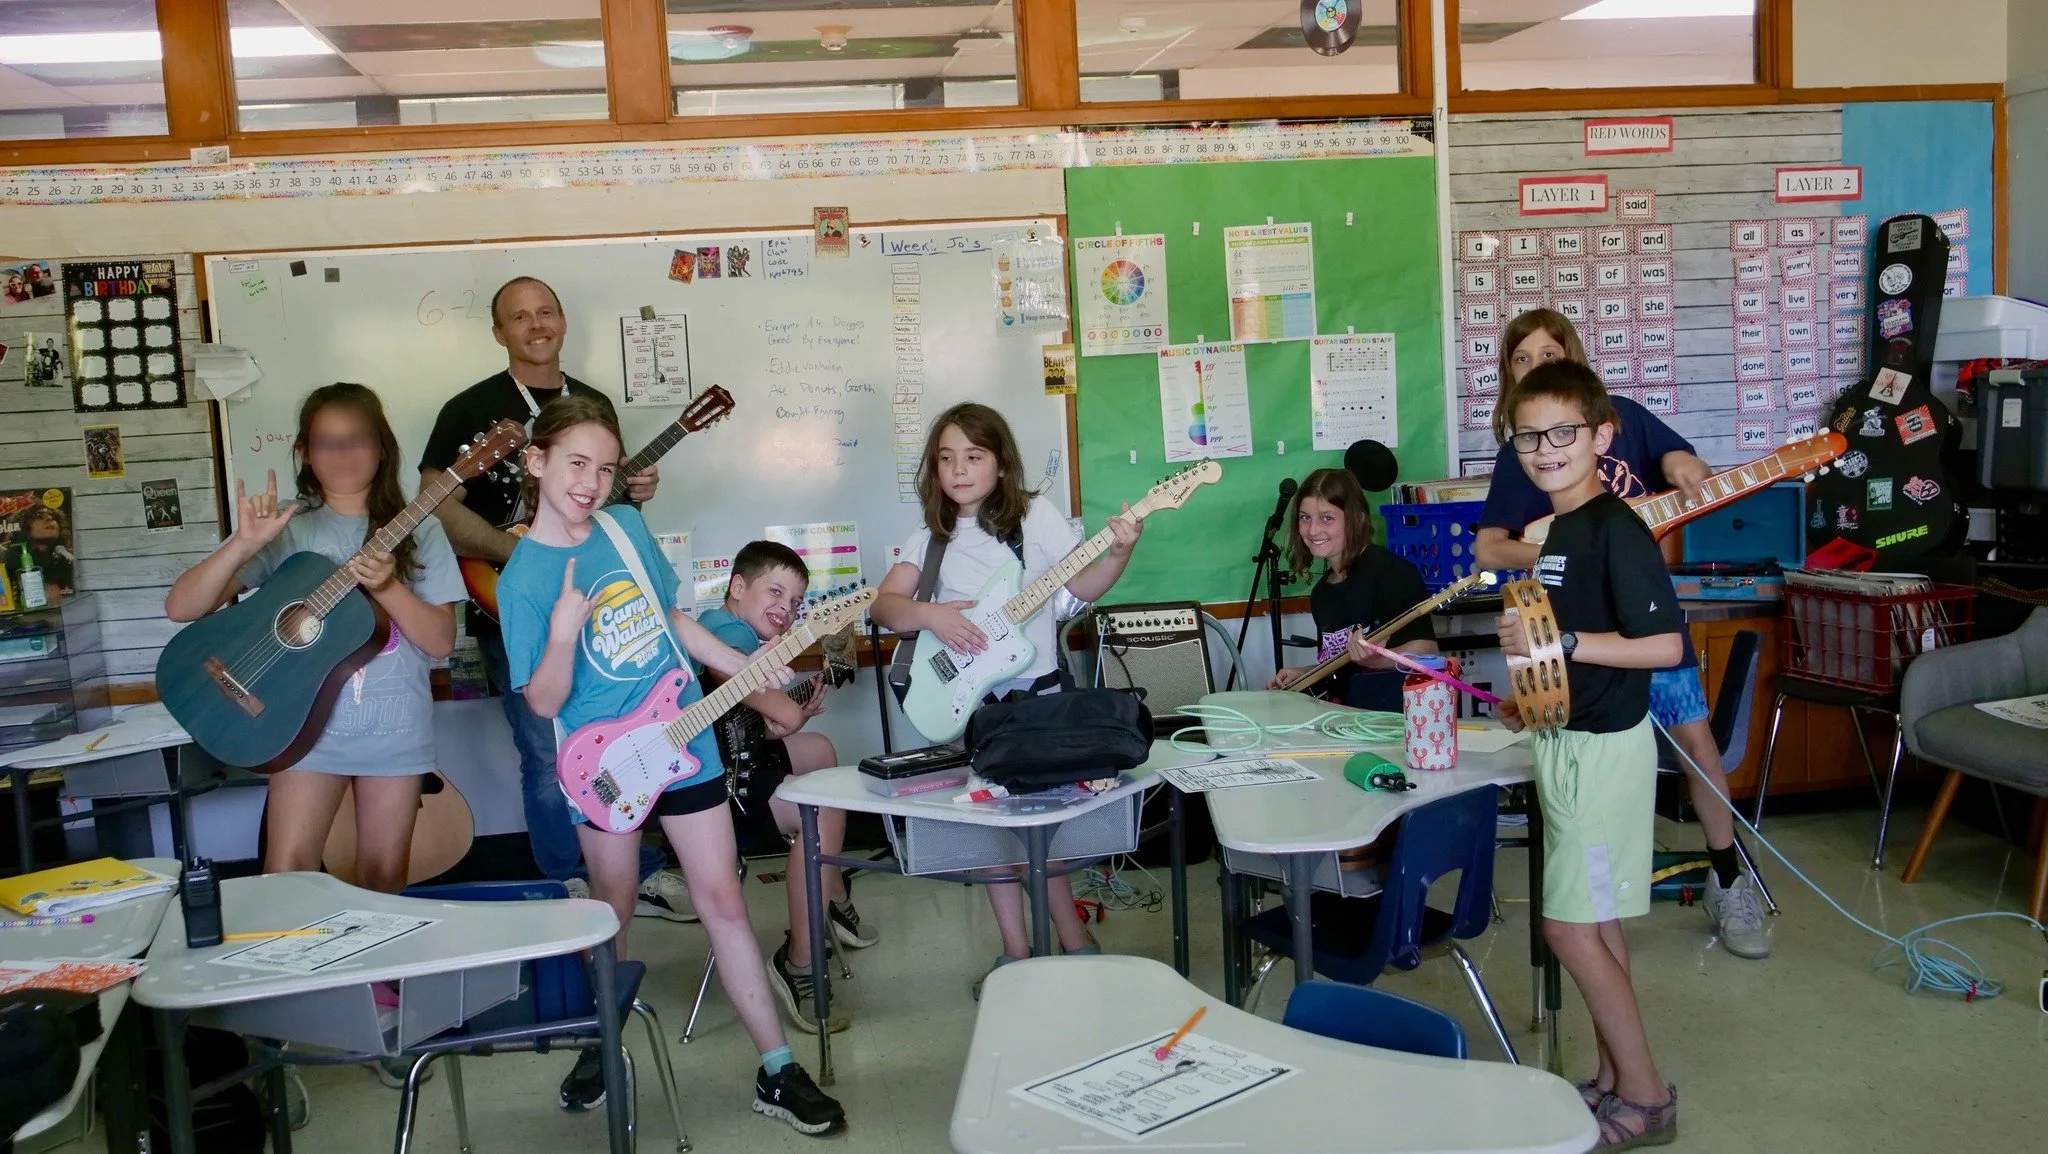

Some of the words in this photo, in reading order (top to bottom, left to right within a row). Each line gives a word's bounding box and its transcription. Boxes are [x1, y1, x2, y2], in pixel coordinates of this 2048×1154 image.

[1589, 126, 1617, 140] RED
[1619, 127, 1667, 139] WORDS
[6, 186, 19, 196] 24
[27, 186, 40, 196] 25
[69, 185, 82, 195] 27
[90, 185, 104, 195] 28
[130, 184, 144, 194] 30
[151, 184, 162, 194] 31
[192, 181, 205, 192] 33
[213, 181, 225, 191] 34
[249, 178, 262, 189] 36
[289, 177, 302, 188] 38
[328, 176, 342, 186] 40
[365, 175, 378, 185] 42
[385, 174, 398, 184] 43
[444, 171, 458, 181] 46
[480, 170, 493, 180] 48
[559, 167, 571, 177] 52
[592, 166, 604, 176] 54
[611, 165, 624, 177] 55
[650, 164, 662, 174] 57
[669, 163, 681, 174] 58
[704, 162, 716, 173] 60
[779, 160, 791, 170] 64
[797, 159, 809, 169] 65
[830, 156, 842, 168] 67
[867, 154, 879, 166] 69
[903, 155, 914, 164] 71
[919, 155, 931, 165] 72
[938, 154, 949, 165] 73
[1009, 151, 1021, 160] 77
[1024, 150, 1036, 160] 78
[1095, 147, 1106, 157] 82
[1126, 146, 1138, 155] 84
[1179, 144, 1190, 154] 87
[1196, 143, 1208, 153] 88
[1227, 143, 1239, 152] 90
[1279, 140, 1291, 150] 93
[1296, 139, 1307, 149] 94
[1328, 138, 1340, 147] 96
[1362, 136, 1374, 146] 98
[1395, 135, 1410, 145] 100
[1786, 177, 1833, 192] LAYER
[1843, 177, 1851, 190] 2
[1531, 188, 1579, 202] LAYER
[1590, 189, 1595, 201] 1
[1625, 198, 1647, 211] said
[1228, 230, 1250, 238] NOTE
[1257, 228, 1277, 237] REST
[1278, 226, 1309, 235] VALUES
[1743, 230, 1755, 241] all
[1791, 229, 1804, 237] as
[1838, 227, 1859, 238] even
[1077, 239, 1113, 250] CIRCLE
[1114, 239, 1128, 248] OF
[1129, 237, 1163, 247] FIFTHS
[1520, 238, 1527, 250] I
[1557, 237, 1577, 249] the
[1601, 235, 1621, 247] for
[1642, 233, 1664, 245] and
[1475, 243, 1483, 252] a
[1787, 261, 1811, 273] every
[1834, 256, 1859, 268] watch
[97, 265, 140, 280] HAPPY
[1604, 267, 1619, 279] of
[1642, 267, 1665, 279] was
[1740, 263, 1763, 275] many
[1475, 275, 1484, 286] is
[1514, 275, 1536, 285] see
[1558, 271, 1579, 283] has
[84, 279, 153, 297] BIRTHDAY
[1788, 294, 1805, 304] live
[1833, 290, 1858, 302] very
[1562, 302, 1578, 315] his
[1605, 303, 1620, 315] go
[1644, 300, 1664, 312] she
[1742, 299, 1759, 307] our
[1474, 308, 1489, 320] he
[1741, 327, 1762, 339] their
[1788, 328, 1809, 336] own
[1835, 324, 1857, 335] which
[1313, 338, 1339, 346] GUITAR
[1605, 333, 1624, 347] put
[1644, 330, 1665, 343] how
[1160, 348, 1191, 358] MUSIC
[1193, 344, 1243, 355] DYNAMICS
[1474, 341, 1490, 354] by
[1043, 355, 1075, 368] BEATLES
[1741, 360, 1765, 372] done
[1789, 355, 1811, 368] gone
[1835, 355, 1857, 365] about
[1605, 364, 1628, 376] what
[1645, 362, 1670, 374] want
[1475, 372, 1498, 388] you
[1792, 389, 1815, 401] goes
[1839, 383, 1858, 395] of
[1646, 394, 1669, 408] they
[1746, 392, 1764, 402] look
[1472, 408, 1491, 418] doe
[1746, 428, 1766, 442] give
[1793, 423, 1815, 436] why
[143, 485, 178, 499] Queen
[809, 524, 856, 534] COUNTING
[1875, 524, 1929, 549] SHURE
[597, 596, 648, 635] Camp
[591, 614, 660, 659] Walden
[1125, 634, 1174, 643] acoustic
